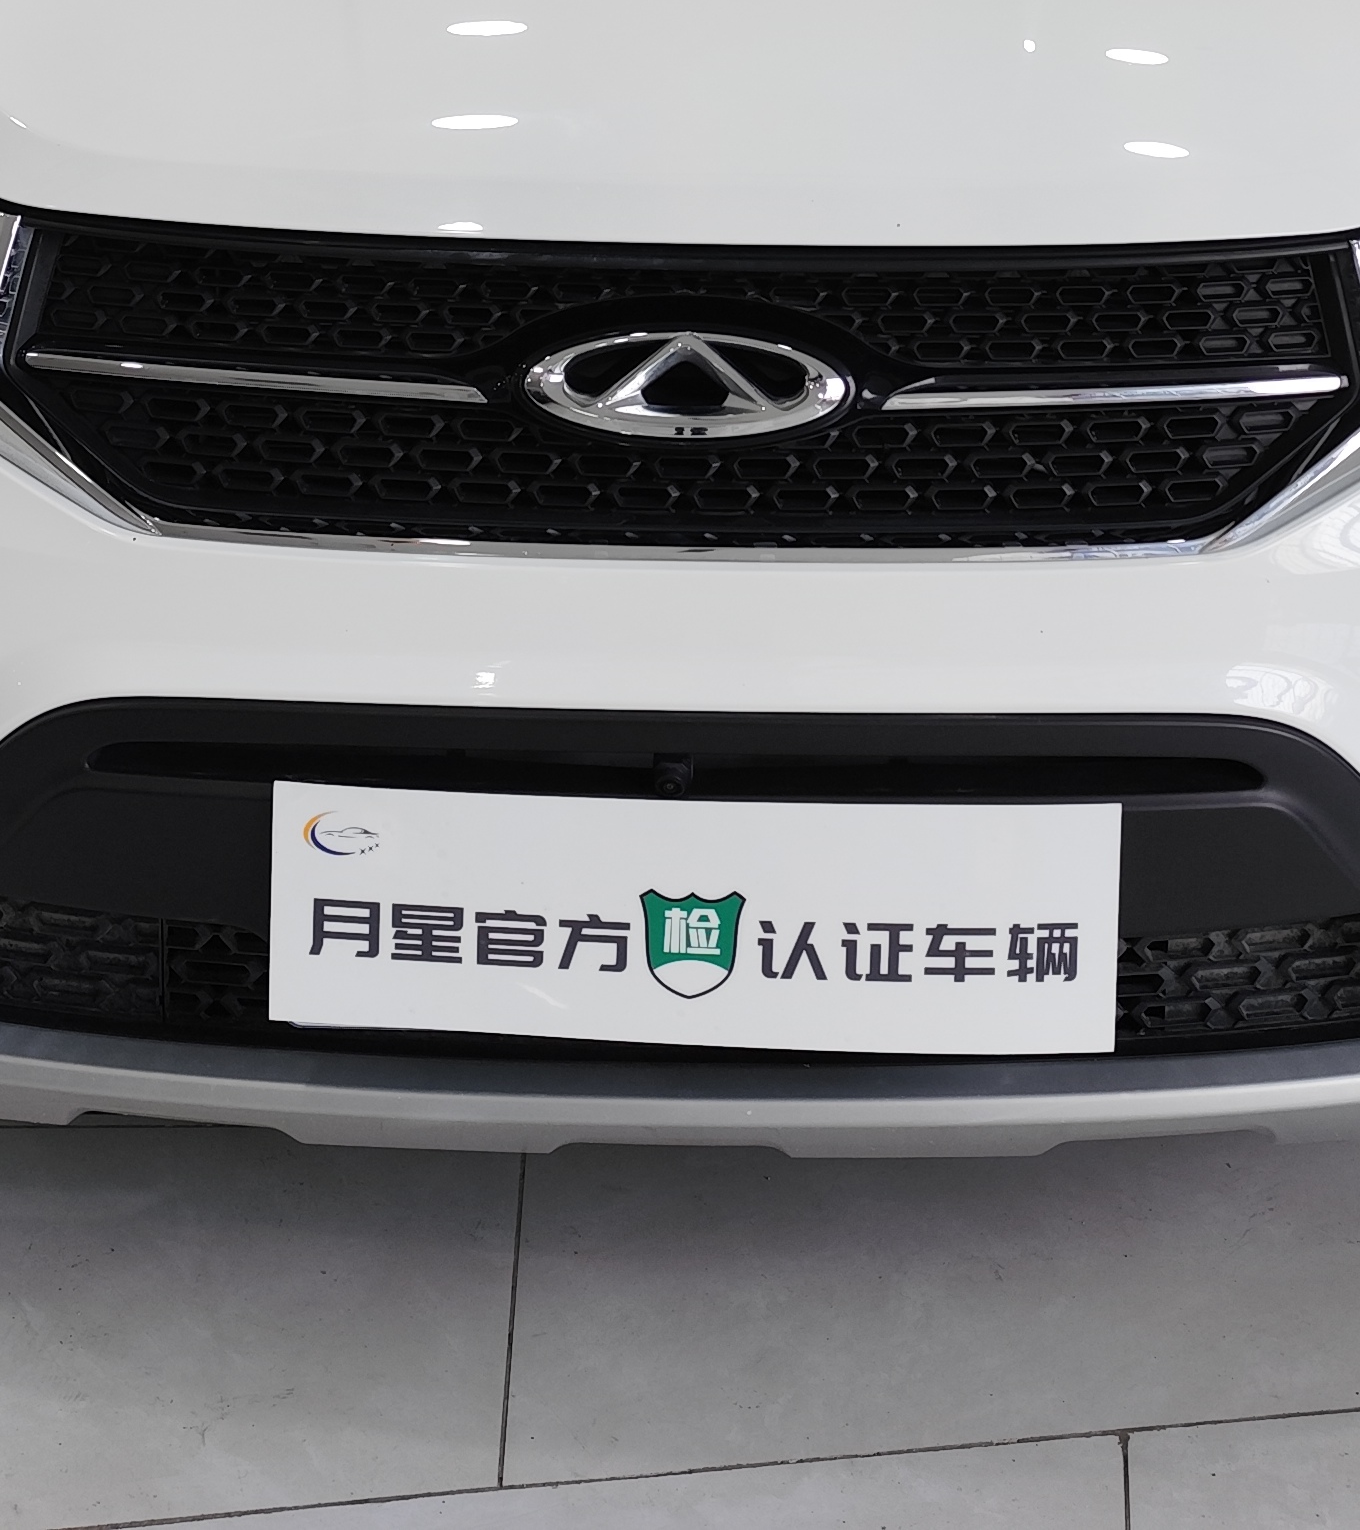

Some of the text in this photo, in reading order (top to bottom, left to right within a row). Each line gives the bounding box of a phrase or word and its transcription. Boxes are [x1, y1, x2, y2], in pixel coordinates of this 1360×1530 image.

[308, 896, 1080, 983] 月星官方 检 认证车辆
